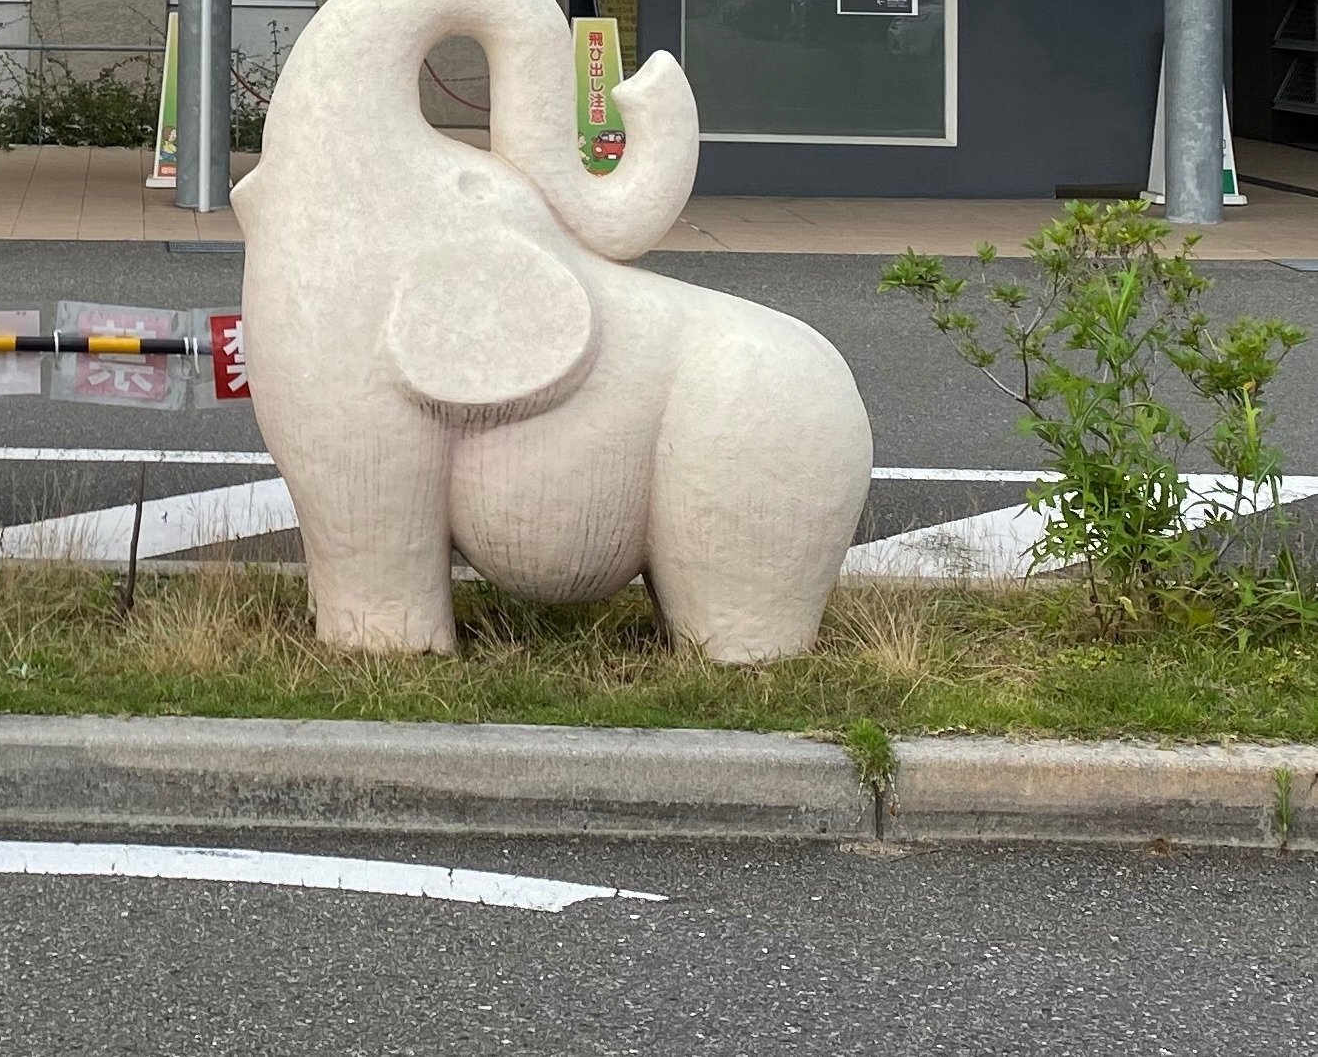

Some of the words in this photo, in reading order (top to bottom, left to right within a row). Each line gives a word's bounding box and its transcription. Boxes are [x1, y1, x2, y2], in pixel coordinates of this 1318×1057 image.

[588, 31, 605, 124] 飛び出し注意
